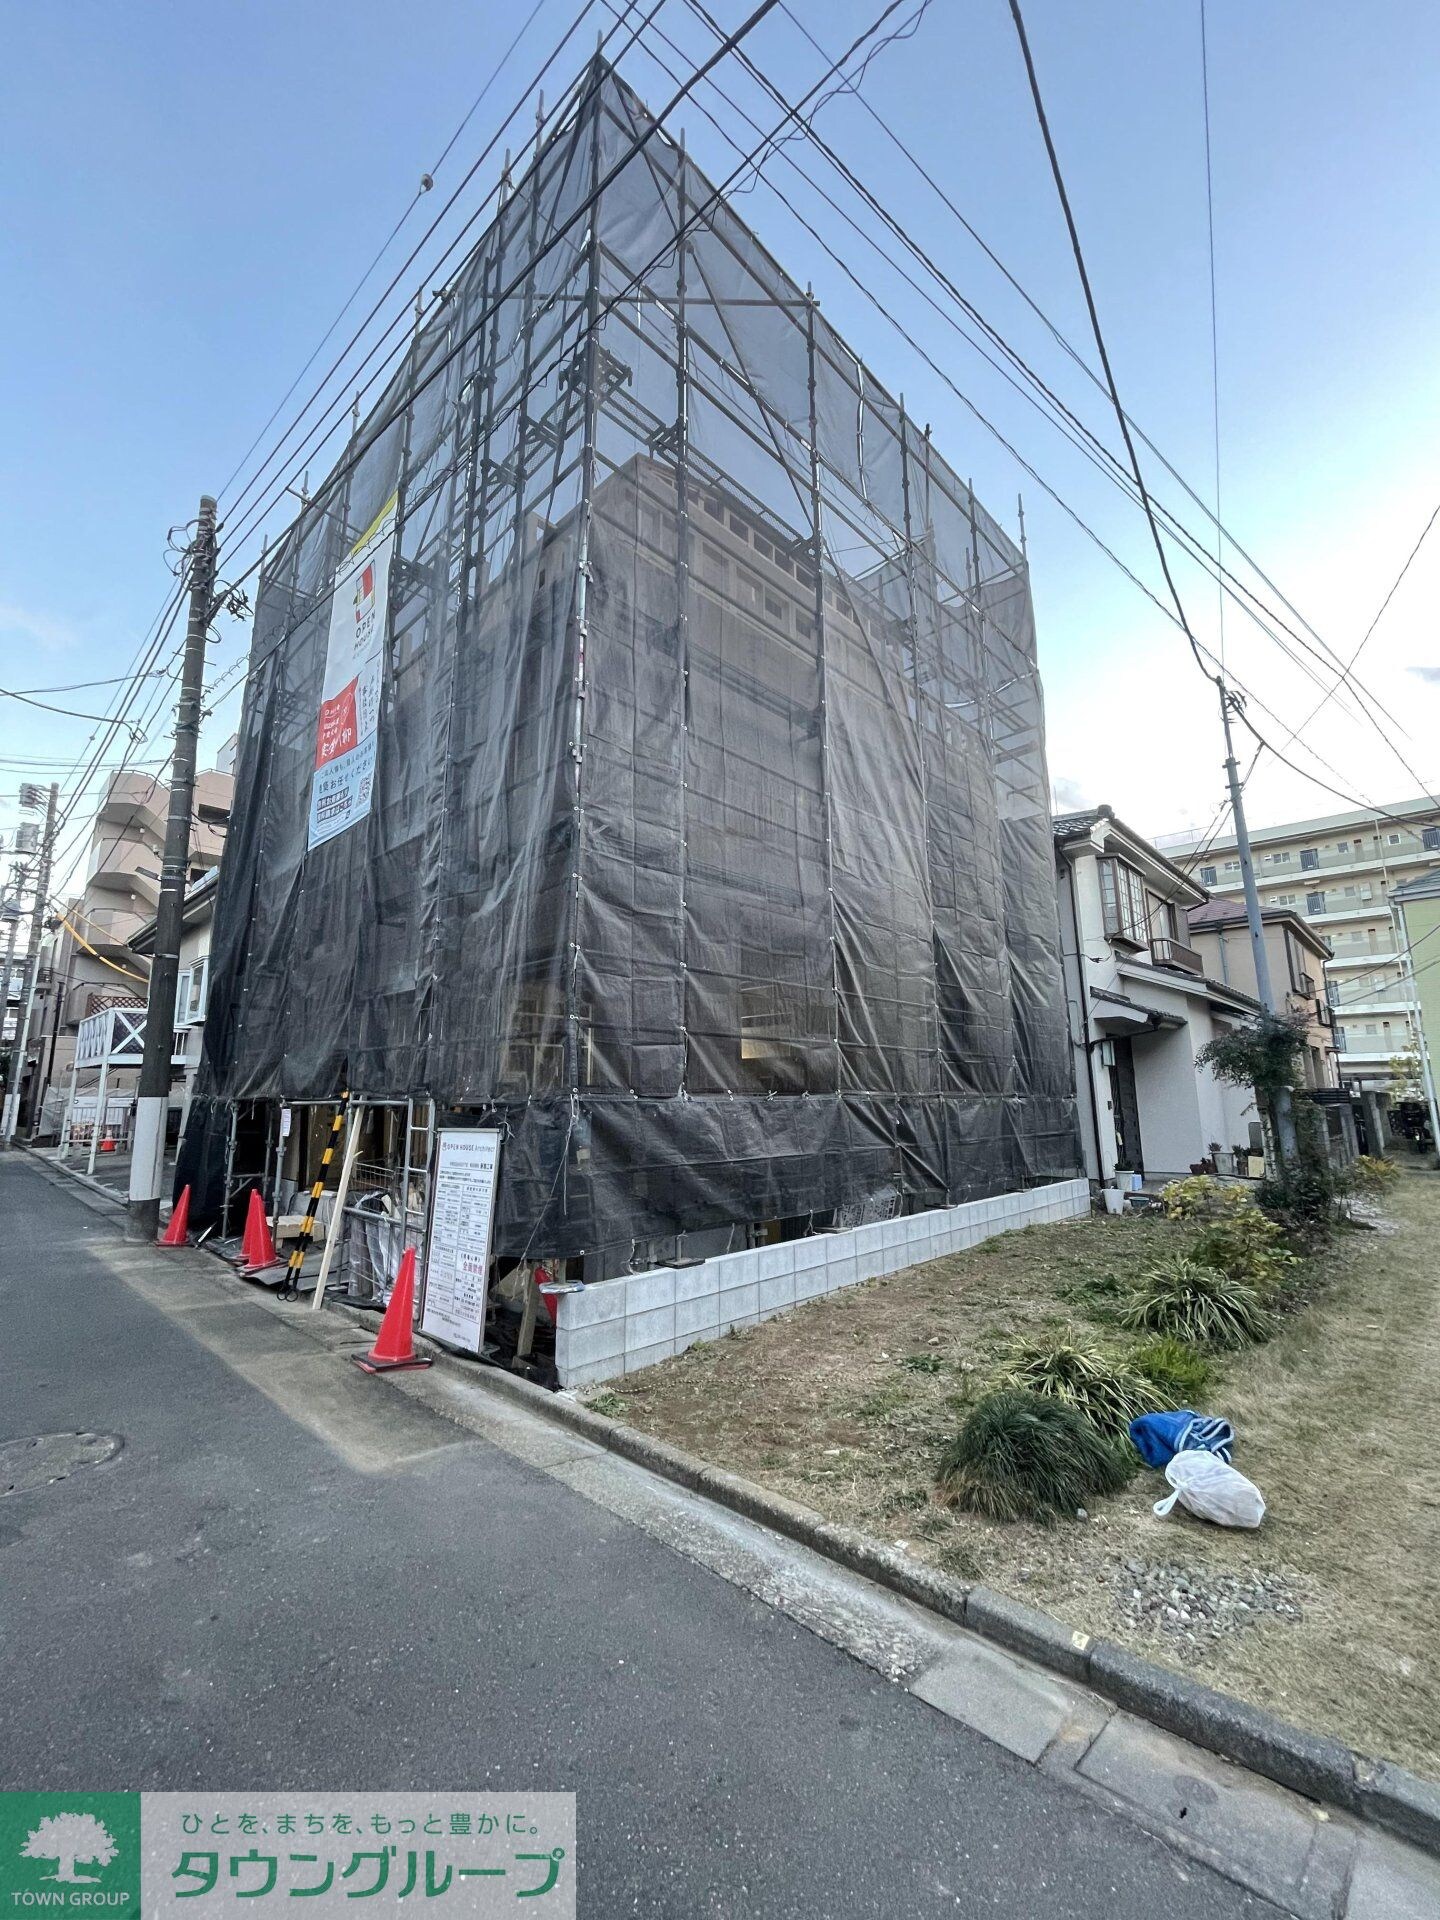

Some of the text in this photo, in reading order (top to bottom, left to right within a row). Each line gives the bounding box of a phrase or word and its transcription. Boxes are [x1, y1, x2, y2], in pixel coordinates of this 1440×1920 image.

[355, 609, 376, 639] OPEN
[447, 1143, 459, 1151] OPEN
[460, 1143, 474, 1152] HOUSE
